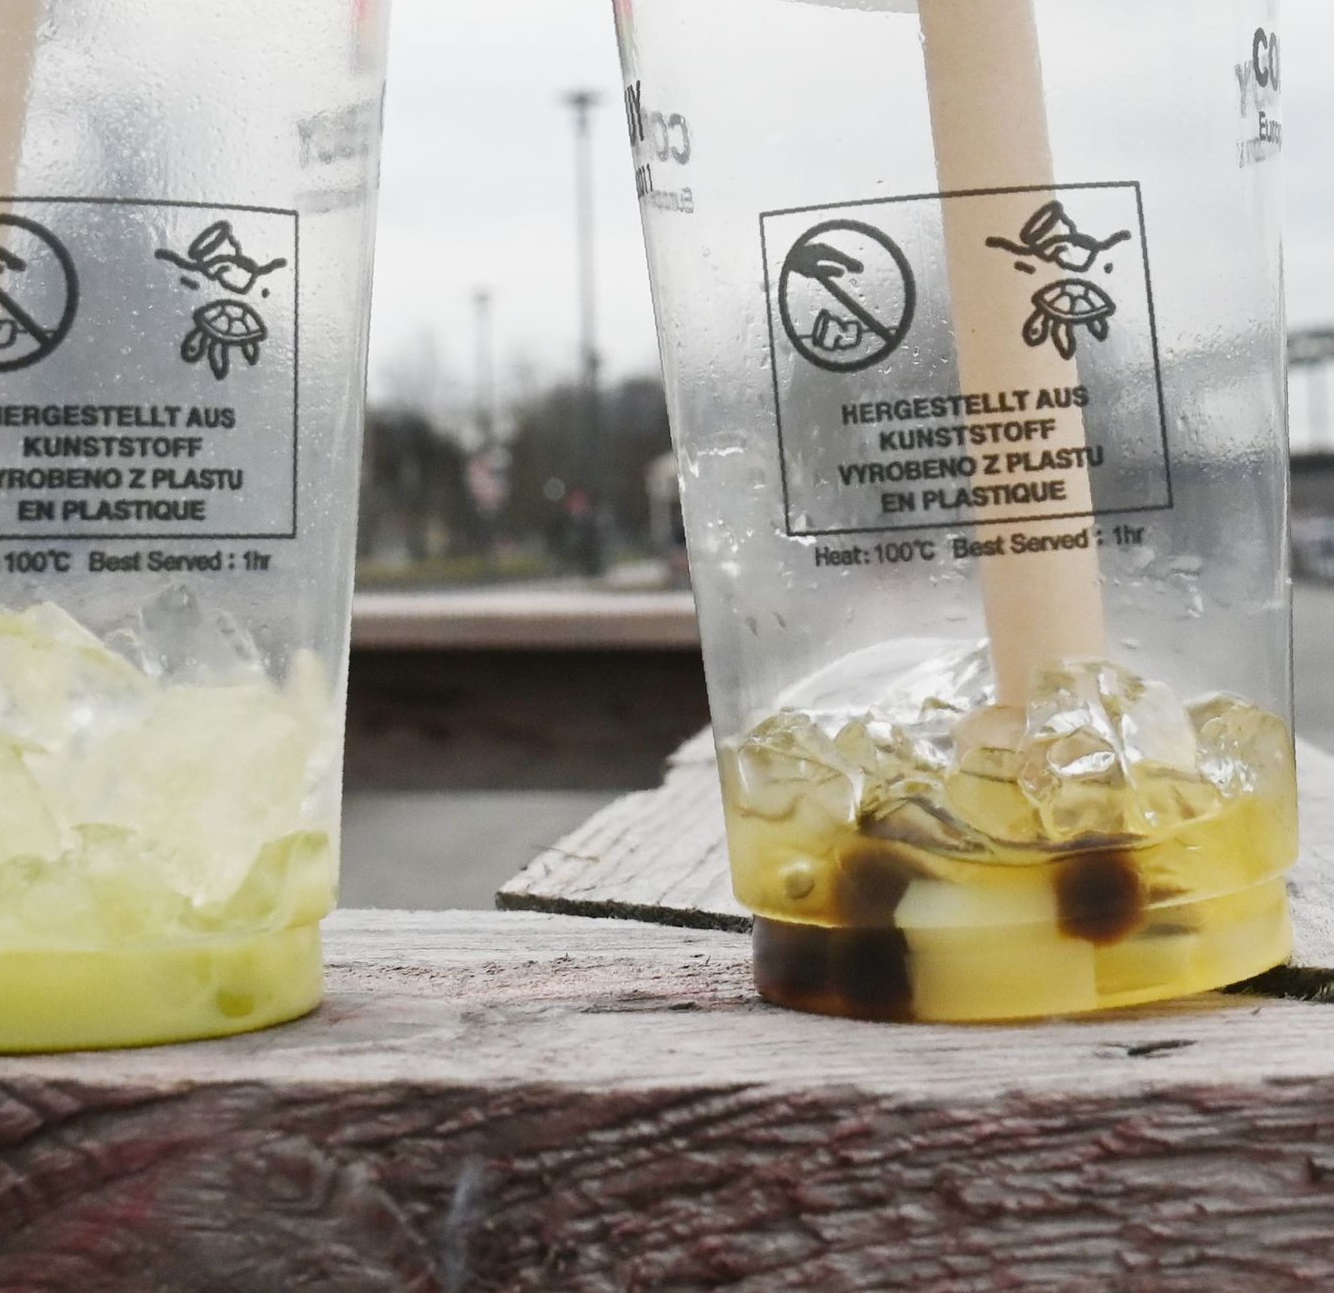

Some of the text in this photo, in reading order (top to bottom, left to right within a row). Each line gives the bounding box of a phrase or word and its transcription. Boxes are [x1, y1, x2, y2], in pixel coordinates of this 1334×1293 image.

[186, 407, 236, 429] AUS
[841, 385, 1090, 425] HERGESTELLT AUS
[23, 437, 203, 458] KUNSTSTOFF
[878, 418, 1056, 451] KUNSTSTOFF
[128, 469, 146, 490] Z
[152, 468, 244, 490] PLASTU
[838, 446, 1104, 486] VYROBENO Z PLASTU
[17, 499, 206, 522] EN PLASTIQUE
[881, 481, 1067, 514] EN PLASTIQUE
[952, 535, 1005, 558] Best
[1010, 528, 1089, 555] Served
[1114, 524, 1145, 546] 1hr
[88, 550, 141, 573] Best
[147, 550, 223, 573] Served
[243, 550, 272, 572] 1hr
